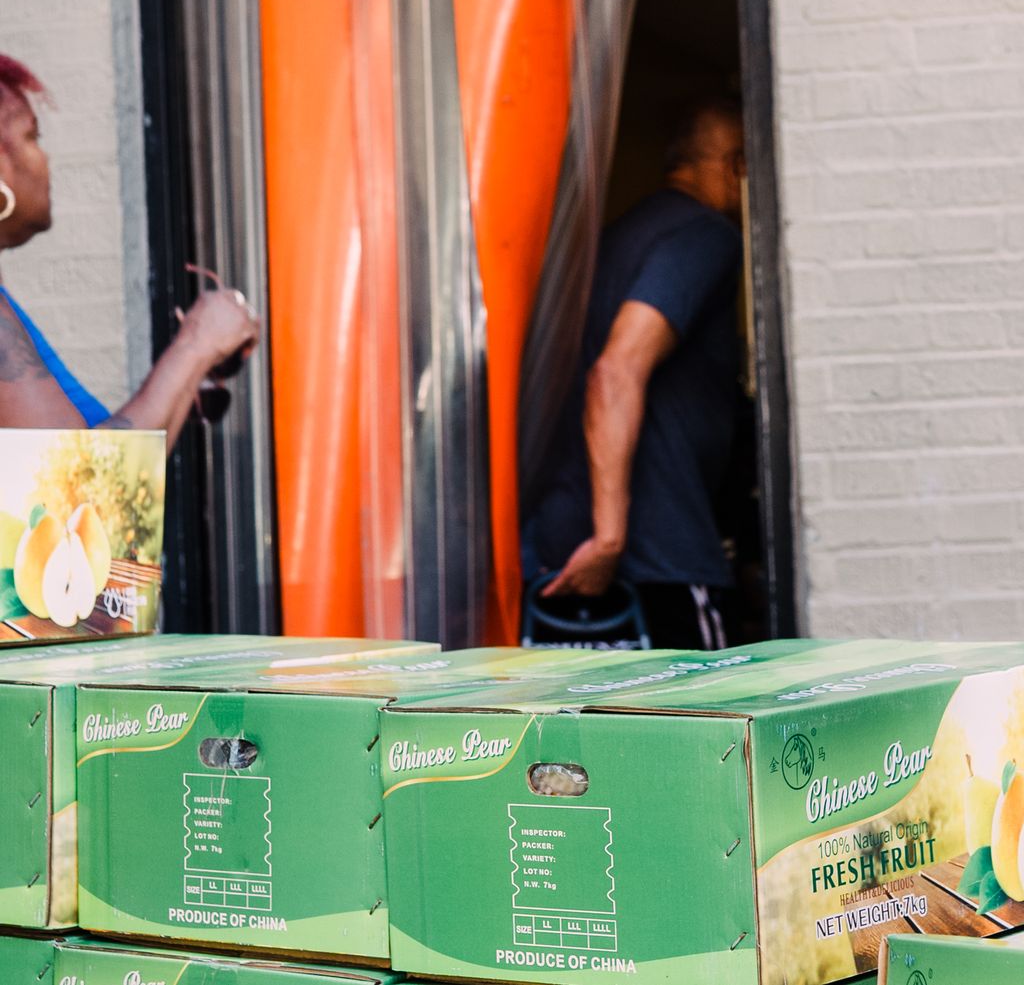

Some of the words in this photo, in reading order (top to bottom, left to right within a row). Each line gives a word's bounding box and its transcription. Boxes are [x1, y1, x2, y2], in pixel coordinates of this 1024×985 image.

[83, 714, 142, 743] Chinese
[145, 704, 189, 734] Pear
[388, 741, 456, 772] Chinese
[462, 728, 512, 761] Pear
[806, 771, 878, 823] Chinese
[883, 740, 933, 788] Pear
[194, 796, 232, 805] INSPECTOR:
[194, 820, 223, 829] VARIETY:
[194, 832, 206, 840] LOT
[521, 829, 566, 838] INSPECTOR:
[818, 836, 849, 859] 100%
[853, 829, 893, 851] Natural
[896, 820, 929, 844] Origin
[522, 841, 554, 850] PACKER:
[522, 854, 556, 863] VARIETY:
[811, 854, 875, 893] FRESH
[881, 838, 936, 875] FRUIT
[538, 868, 552, 876] NO:
[209, 881, 217, 890] LL
[230, 883, 242, 891] LLL
[543, 881, 557, 890] 7kg
[168, 907, 227, 926] PRODUCE
[230, 913, 246, 927] OF
[249, 916, 288, 931] CHINA
[516, 925, 532, 934] SIZE
[543, 920, 552, 928] LL
[568, 922, 581, 930] LLL
[593, 924, 611, 933] LLLL
[816, 915, 843, 939] NET
[496, 949, 565, 968] PRODUCE
[568, 955, 587, 969] OF
[591, 957, 637, 974] CHINA
